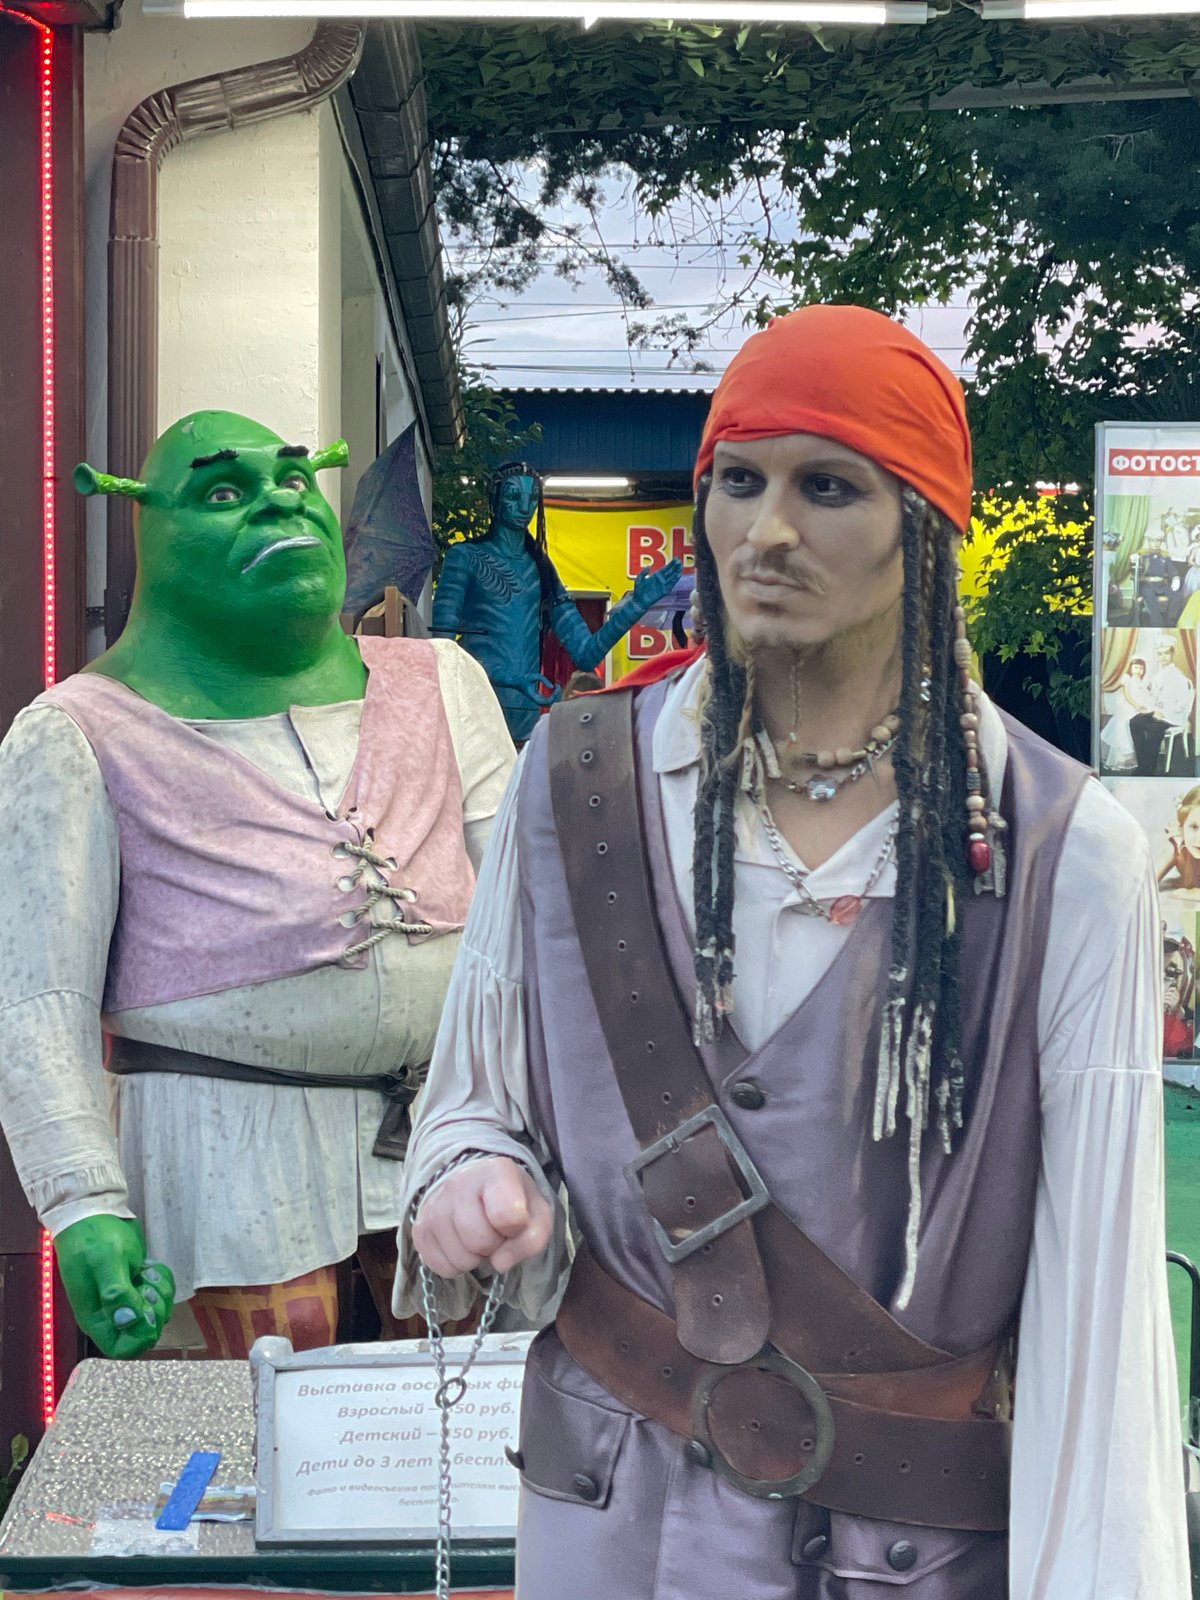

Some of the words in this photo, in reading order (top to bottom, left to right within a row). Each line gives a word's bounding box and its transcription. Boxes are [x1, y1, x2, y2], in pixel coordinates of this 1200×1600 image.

[297, 1382, 396, 1397] Выставка
[402, 1380, 492, 1391] восых
[337, 1402, 425, 1419] Взрослый
[479, 1401, 516, 1417] руб.
[339, 1427, 421, 1445] Детский
[448, 1427, 473, 1439] 50
[477, 1426, 514, 1441] руб.
[295, 1458, 349, 1477] Дети
[353, 1455, 375, 1468] до
[380, 1456, 391, 1468] 3
[394, 1456, 433, 1468] лет
